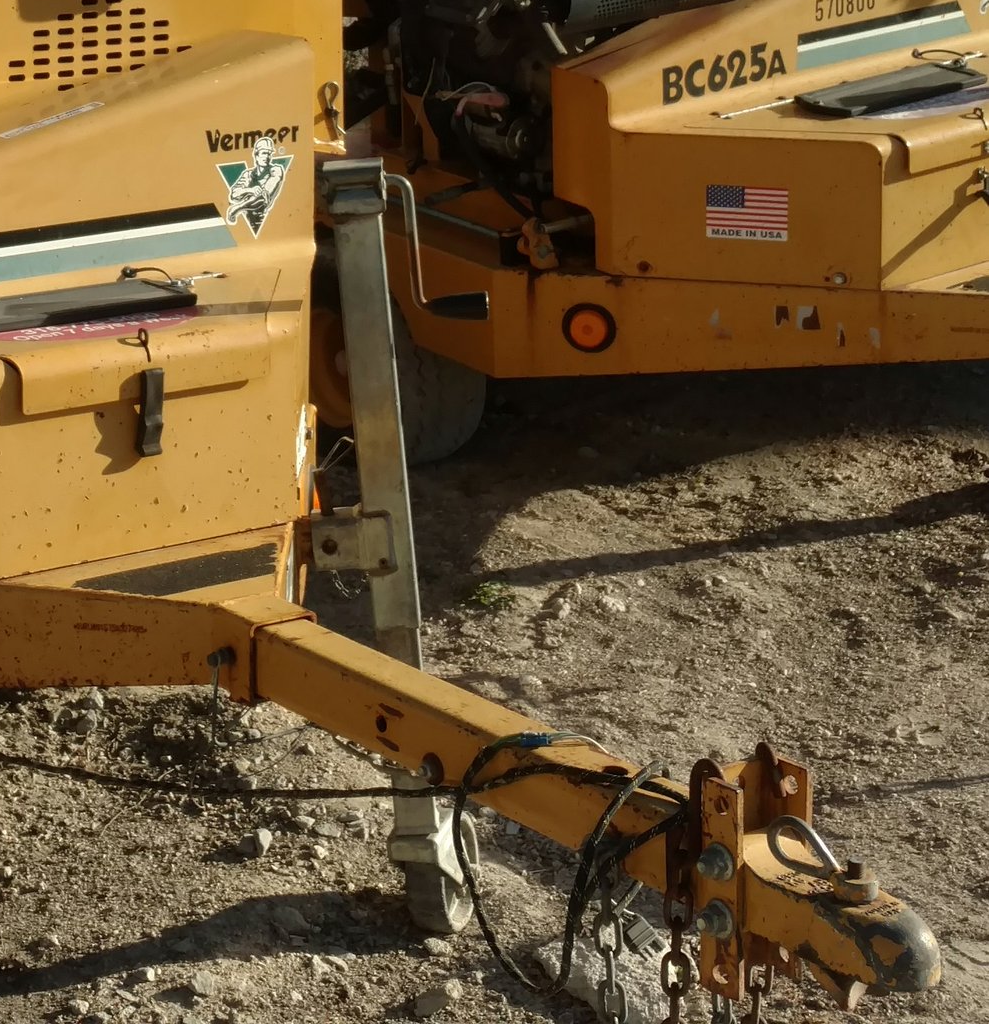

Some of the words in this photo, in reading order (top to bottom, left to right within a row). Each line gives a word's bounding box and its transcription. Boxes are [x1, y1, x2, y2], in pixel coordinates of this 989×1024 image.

[662, 42, 787, 105] BC625A
[206, 125, 299, 153] Vermeer
[711, 228, 742, 237] MADE
[760, 231, 782, 239] USA
[13, 330, 64, 342] Open
